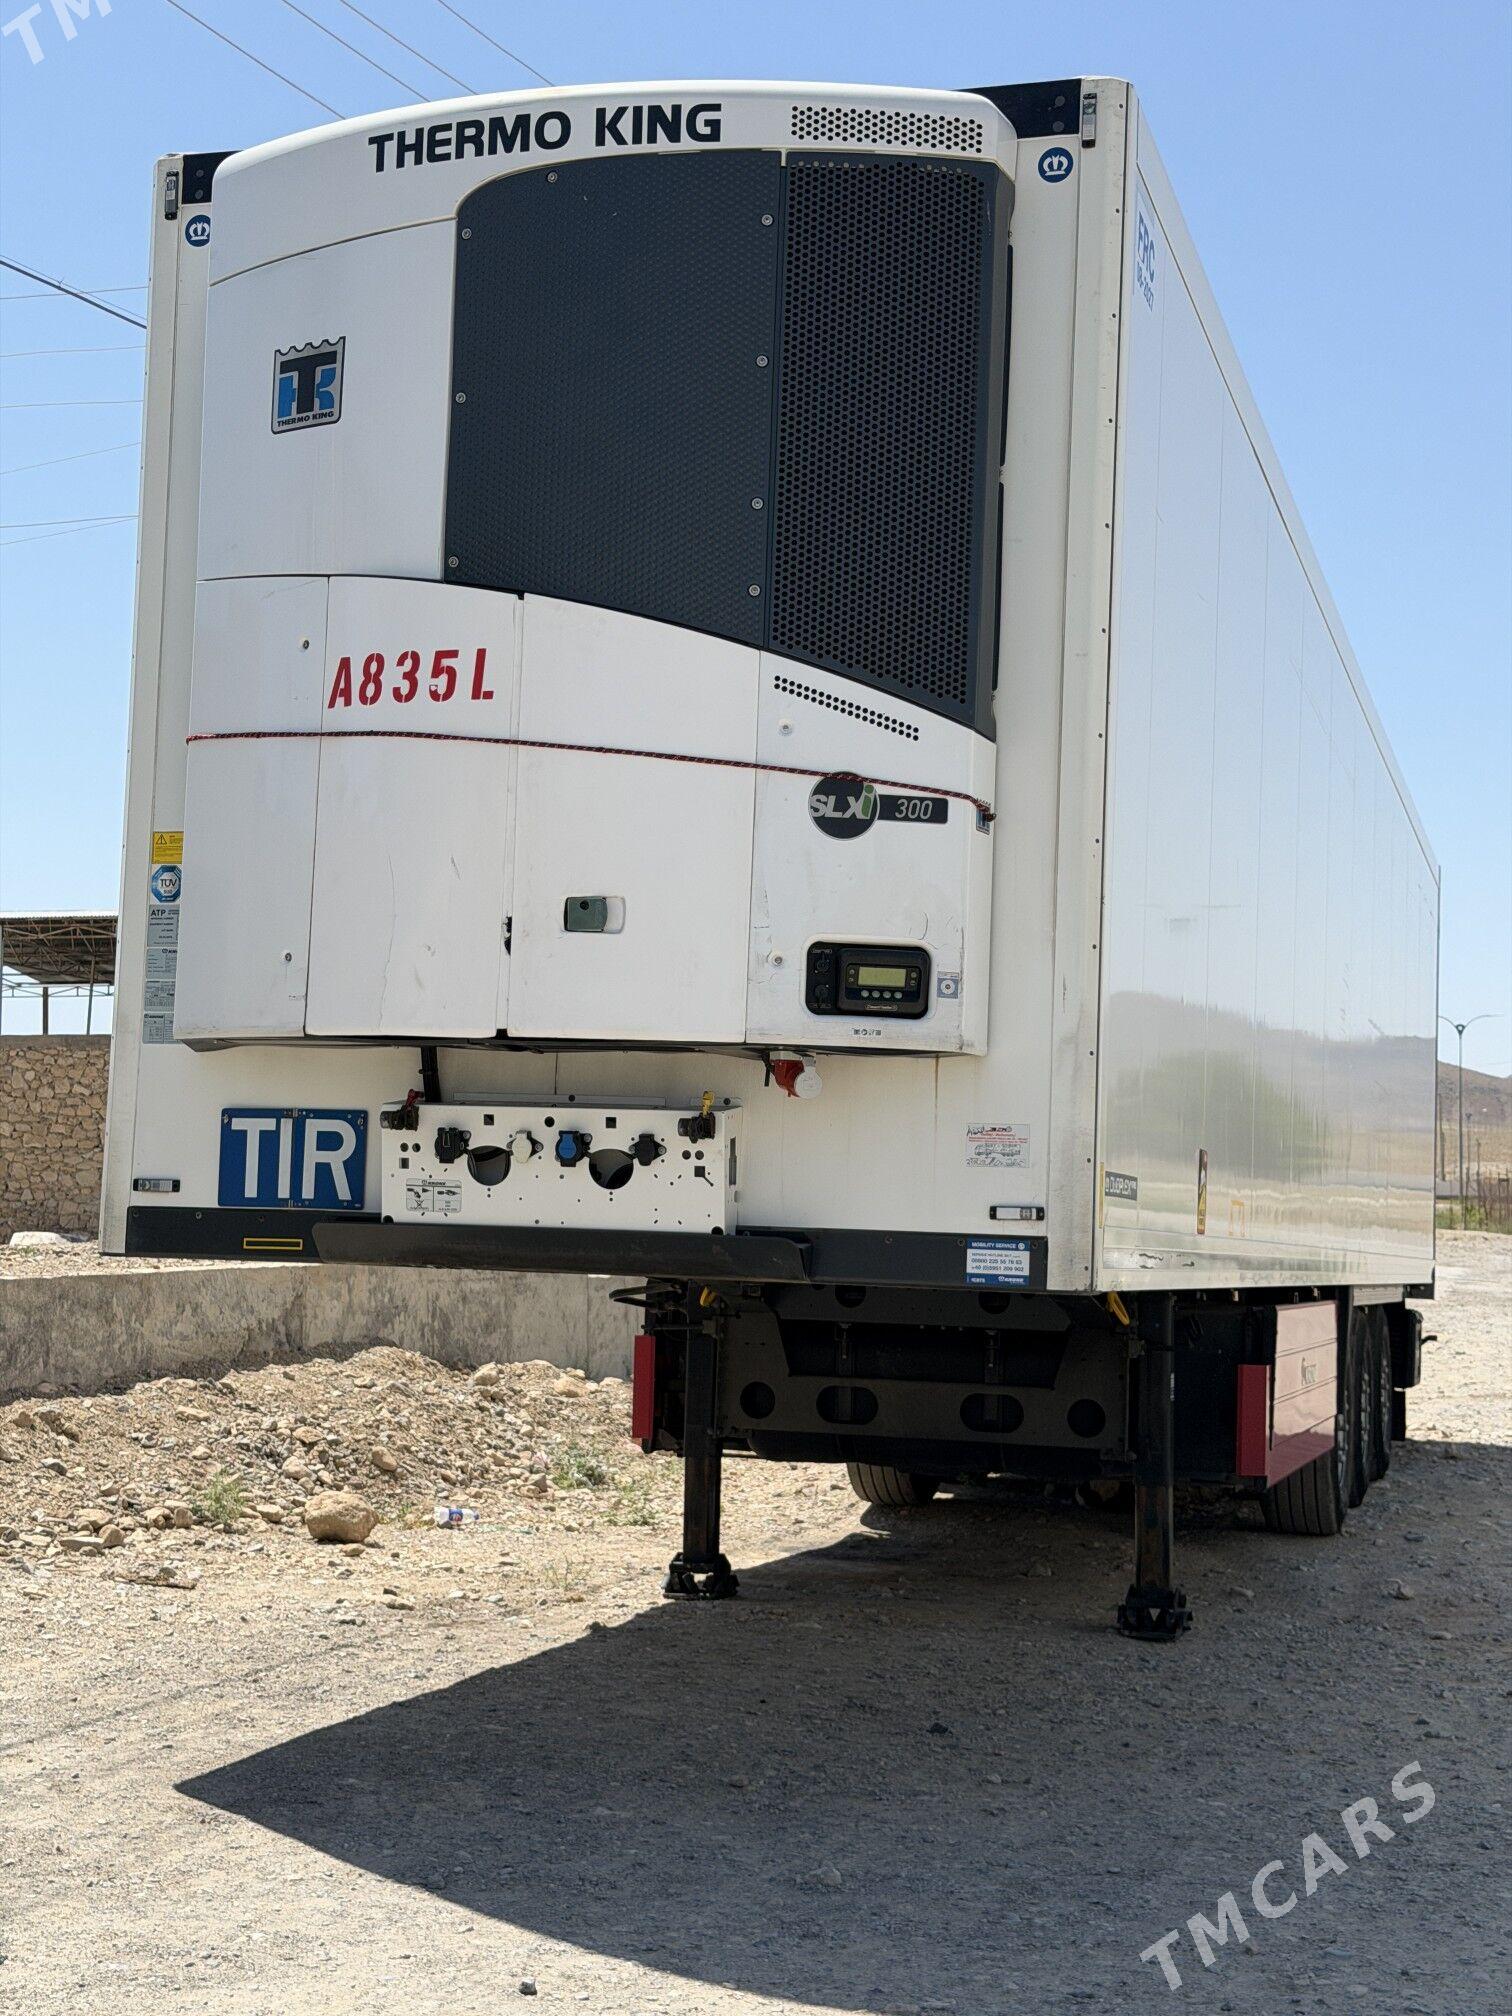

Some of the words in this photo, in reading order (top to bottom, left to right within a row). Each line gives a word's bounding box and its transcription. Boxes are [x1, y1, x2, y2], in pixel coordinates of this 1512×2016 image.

[368, 111, 572, 173] THERMO
[595, 103, 723, 148] KING
[1138, 210, 1155, 284] FRC
[276, 415, 311, 428] THERMO
[312, 410, 335, 421] KING
[327, 648, 495, 709] A835L
[809, 783, 876, 820] SLXi
[894, 798, 933, 820] 300
[150, 909, 167, 917] ATP
[230, 1117, 353, 1201] TIR
